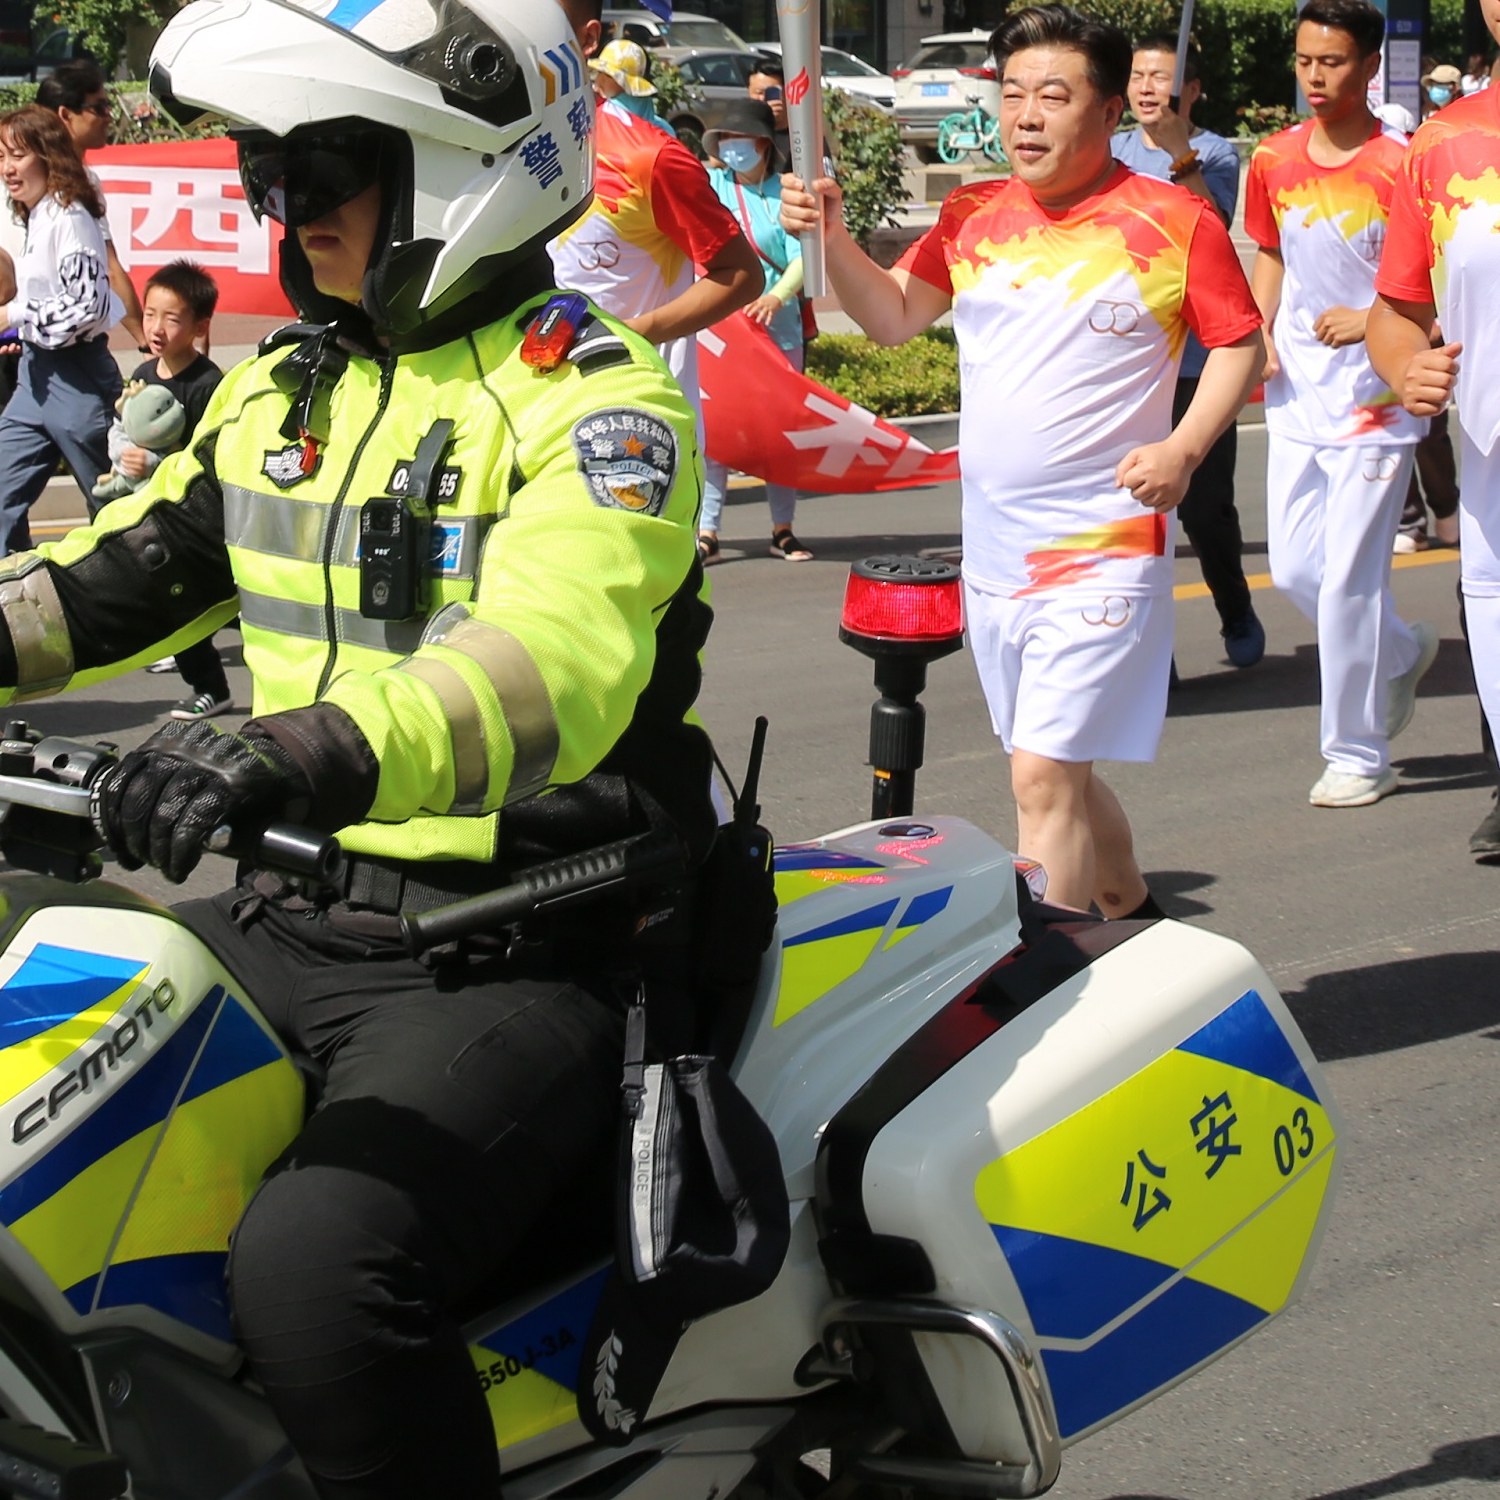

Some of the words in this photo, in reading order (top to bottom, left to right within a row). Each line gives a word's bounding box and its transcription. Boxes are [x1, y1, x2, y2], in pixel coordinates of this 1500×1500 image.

[519, 94, 591, 191] 警察
[791, 130, 804, 179] 1991-
[88, 165, 271, 275] 西
[577, 415, 674, 450] 中华人民共和国
[610, 460, 655, 479] POLICE
[12, 976, 176, 1144] CFMOTO
[636, 1139, 651, 1192] POLICE
[1119, 1089, 1243, 1233] 公安
[1273, 1107, 1315, 1177] 03
